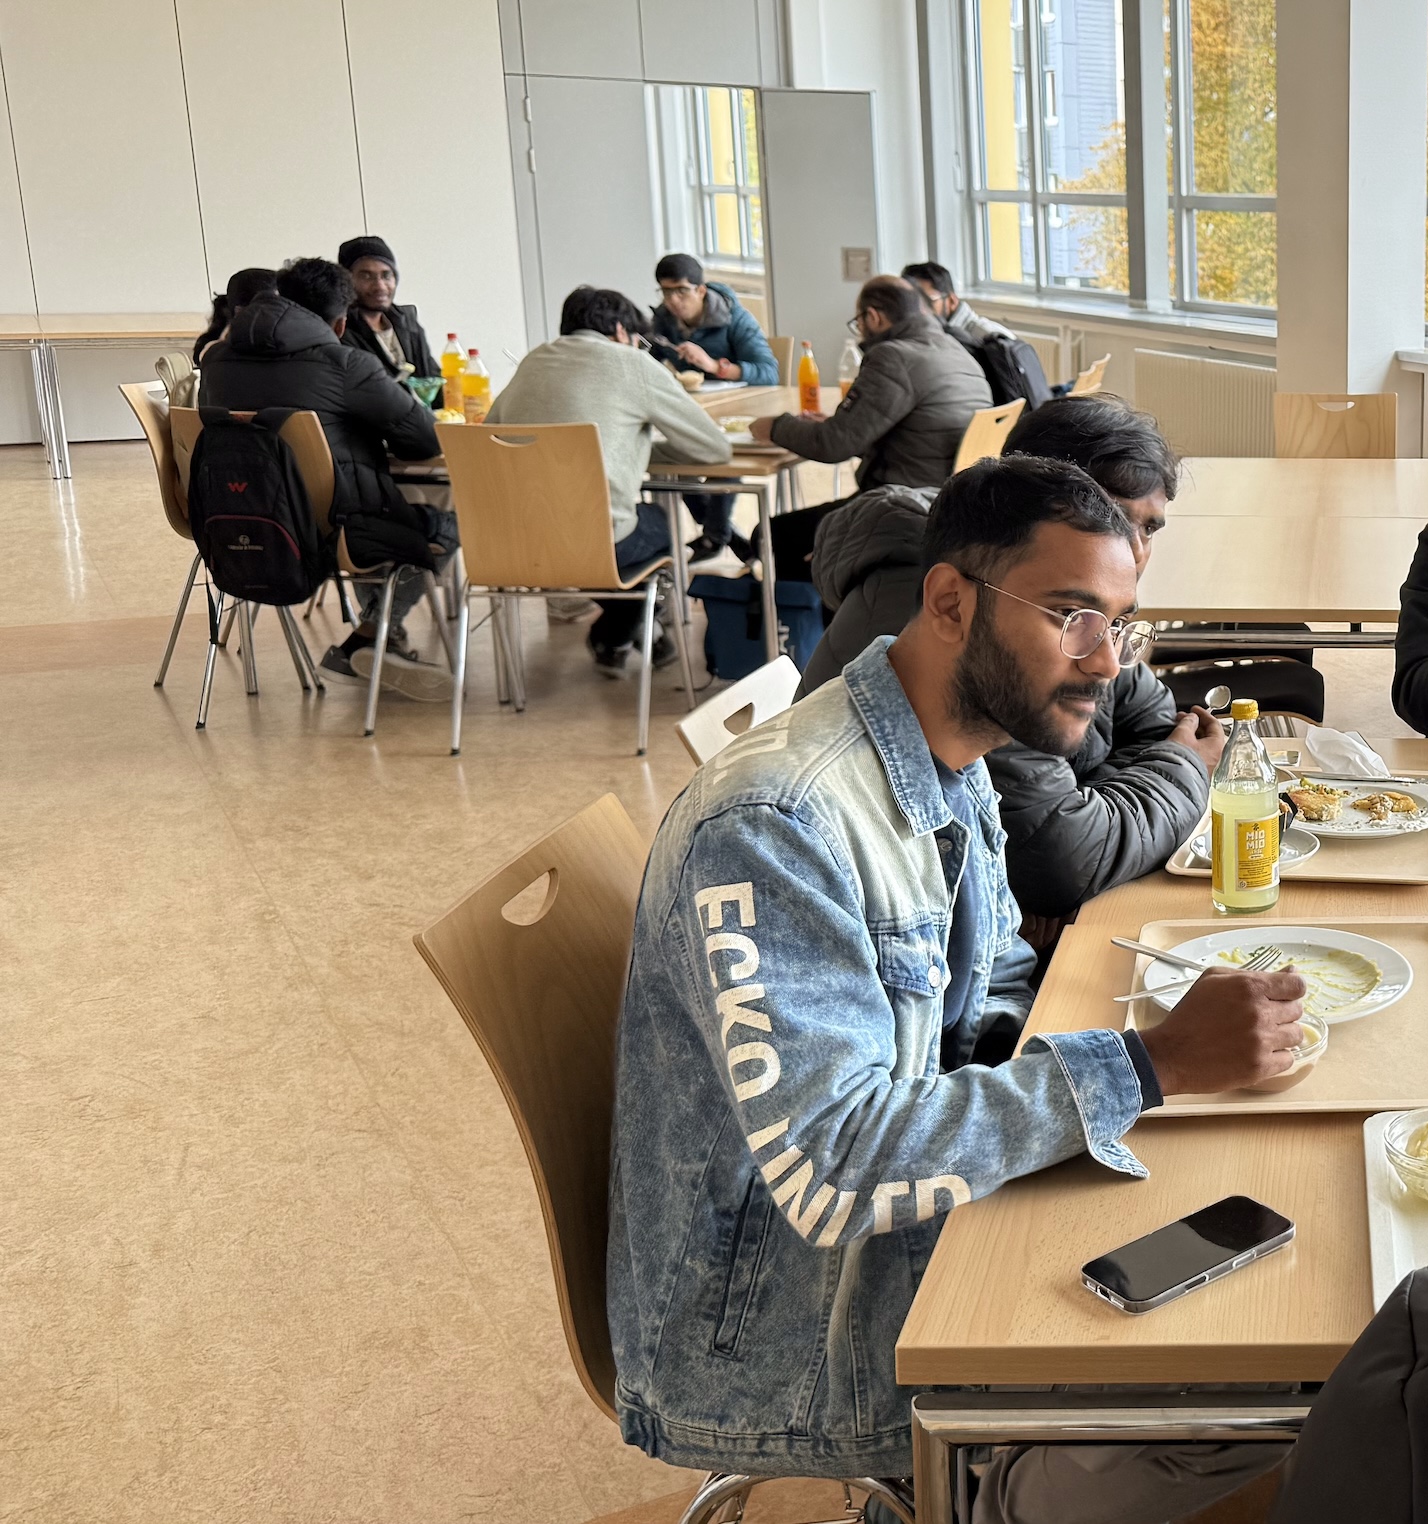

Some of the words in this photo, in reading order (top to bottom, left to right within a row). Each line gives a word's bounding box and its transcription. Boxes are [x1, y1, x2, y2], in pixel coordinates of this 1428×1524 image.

[1246, 830, 1265, 840] MIO
[1246, 839, 1265, 850] MIO
[694, 881, 782, 1102] ECKO
